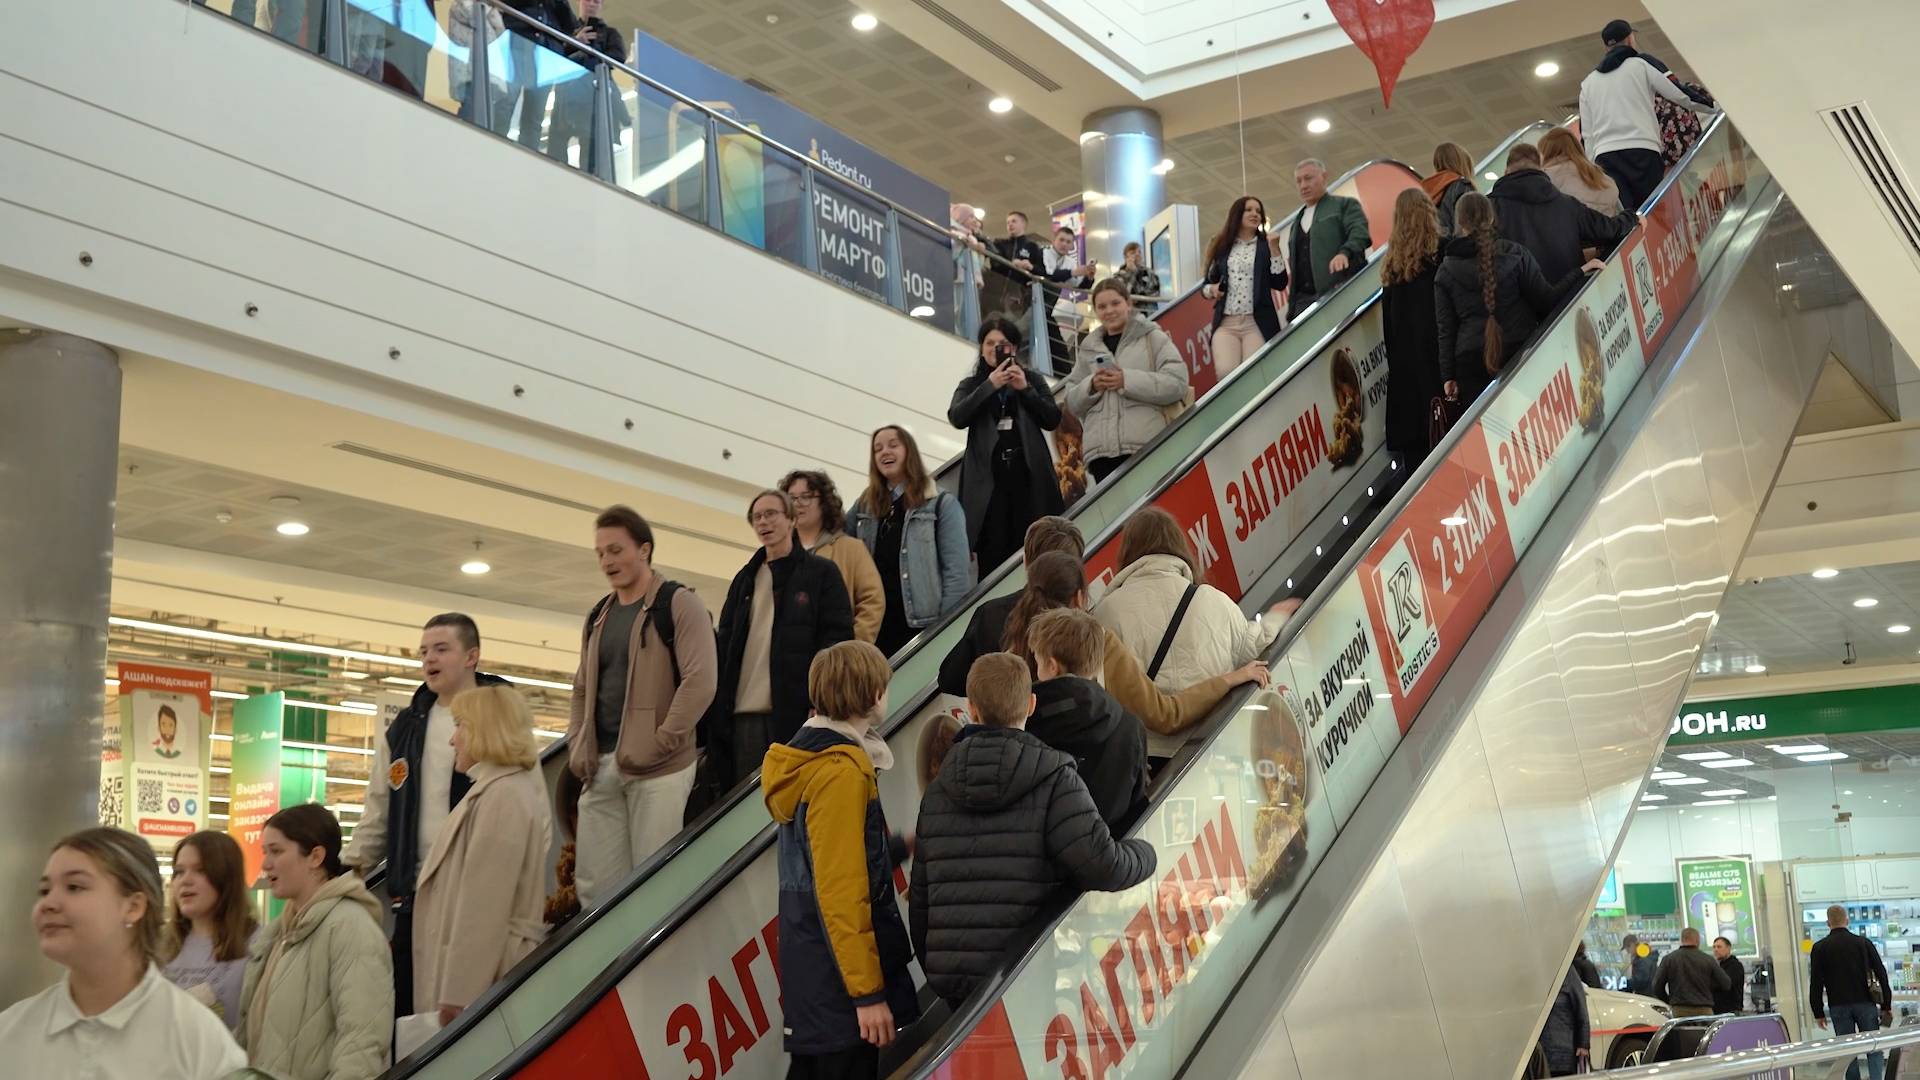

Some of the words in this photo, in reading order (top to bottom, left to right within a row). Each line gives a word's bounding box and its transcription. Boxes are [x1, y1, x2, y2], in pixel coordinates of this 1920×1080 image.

[1656, 247, 1669, 288] 2
[1663, 217, 1692, 278] ЭТАЖ
[1598, 317, 1608, 340] ЗА
[1604, 283, 1628, 332] ВКУСНОЙ
[1186, 338, 1200, 374] 2
[1360, 358, 1372, 379] ЗА
[1605, 317, 1632, 371] КУРОЧКОЙ
[1499, 362, 1580, 506] ЗАГЛЯНИ
[1225, 403, 1329, 542] ЗАГЛЯНИ
[1432, 535, 1452, 594] 2
[1446, 475, 1497, 575] ЭТАЖ
[1388, 561, 1422, 643] R
[123, 671, 155, 682] АШАН
[155, 676, 208, 689] подскажет!
[1305, 691, 1323, 728] ЗА
[1319, 618, 1370, 709] ВКУСНОЙ
[1402, 631, 1438, 690] ROSTIC'S
[1316, 672, 1375, 775] КУРОЧКОЙ
[234, 796, 274, 811] онлайн-
[235, 782, 274, 796] Выдача
[244, 830, 261, 844] тут
[1689, 870, 1722, 880] REALME
[1689, 880, 1703, 888] СО
[1704, 877, 1742, 887] СВЯЗЬЮ
[1044, 800, 1249, 1080] ЗАГЛЯНИ
